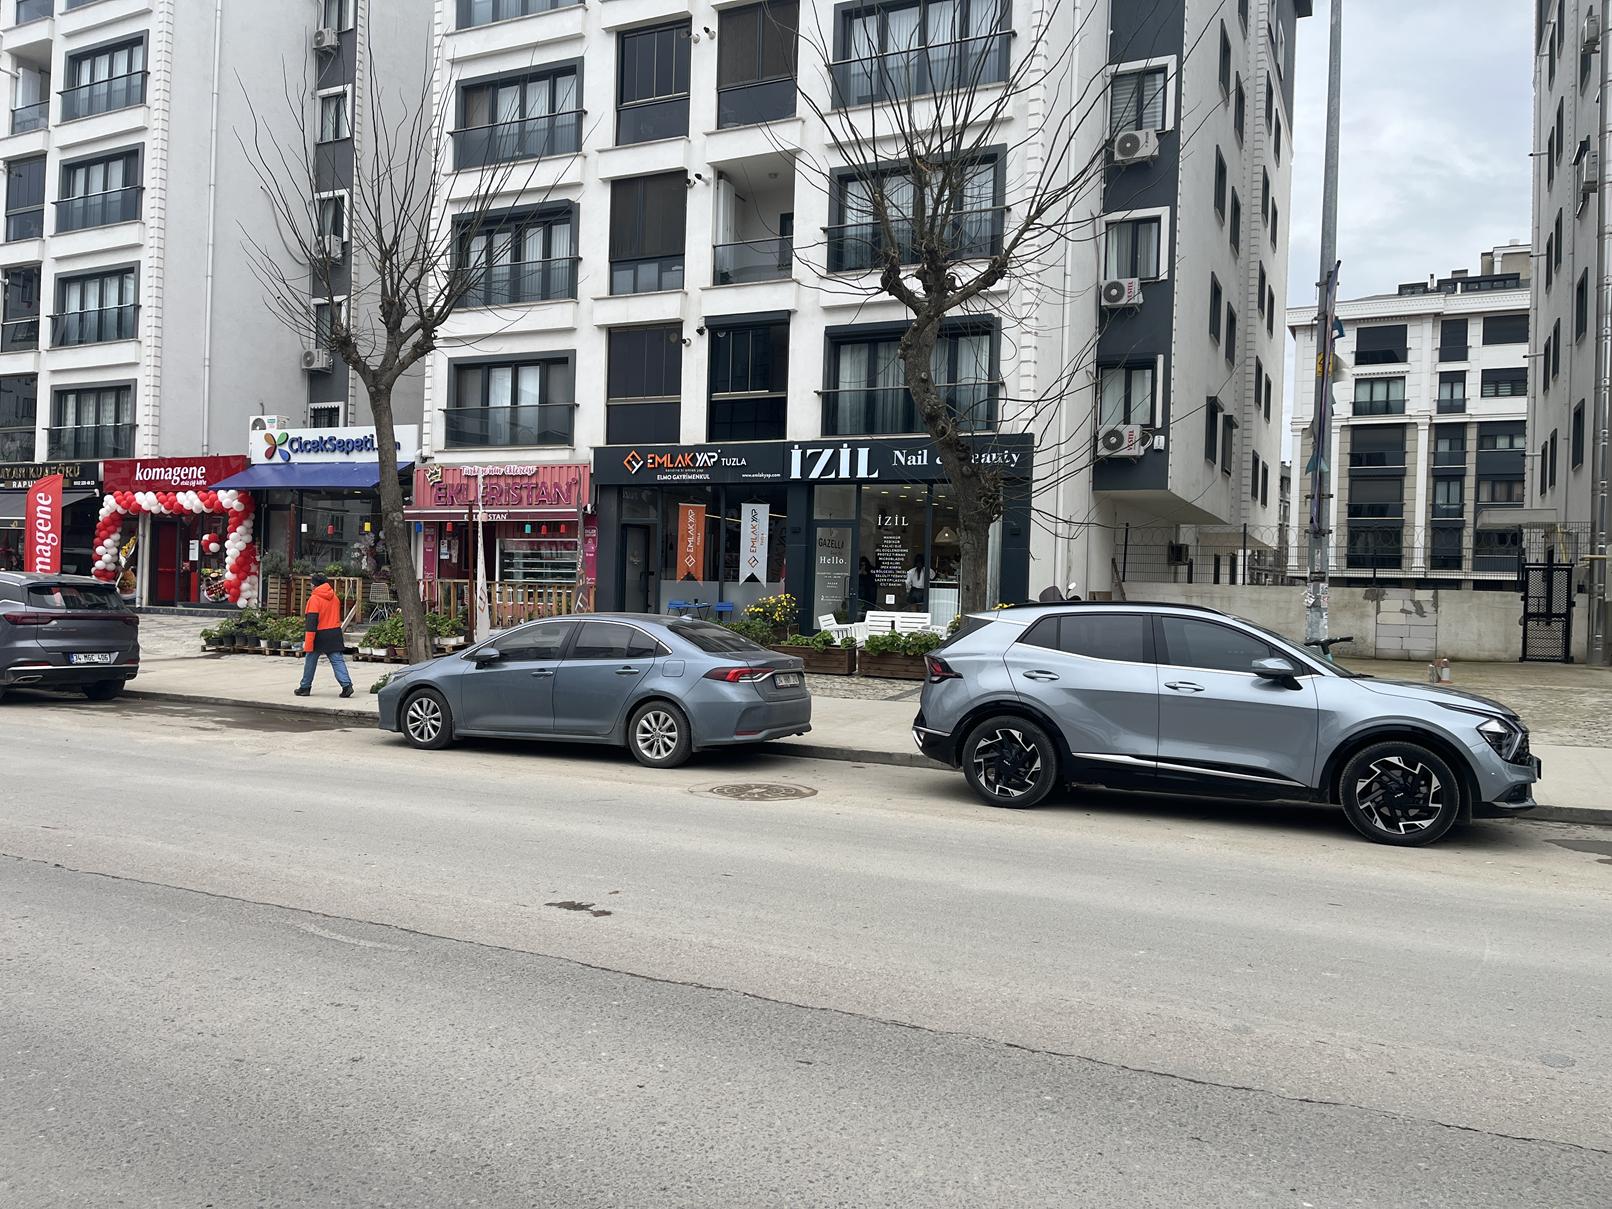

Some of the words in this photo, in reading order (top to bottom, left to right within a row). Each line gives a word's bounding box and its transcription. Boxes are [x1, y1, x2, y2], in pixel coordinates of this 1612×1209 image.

[722, 458, 746, 466] TUZLA
[790, 443, 878, 479] İZİL
[892, 450, 928, 466] Nail
[971, 450, 1020, 468] eauty
[136, 462, 206, 486] komagene
[878, 514, 908, 526] İZİL
[820, 556, 847, 564] Hello.
